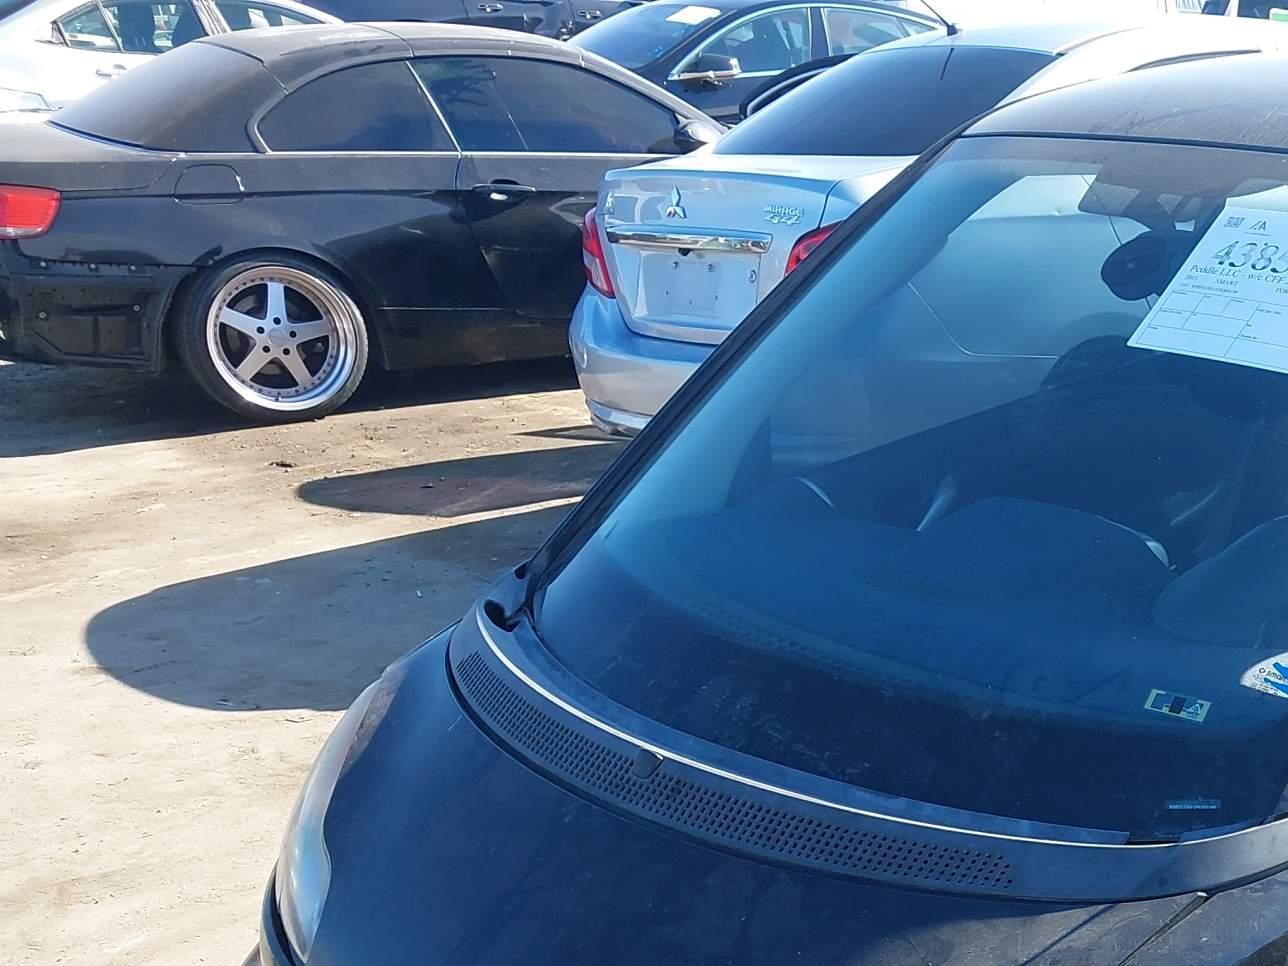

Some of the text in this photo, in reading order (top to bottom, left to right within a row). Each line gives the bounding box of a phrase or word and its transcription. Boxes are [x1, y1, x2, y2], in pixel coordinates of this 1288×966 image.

[763, 204, 805, 216] MIRAGE
[1190, 264, 1219, 276] Peddle
[1218, 268, 1241, 278] LLC
